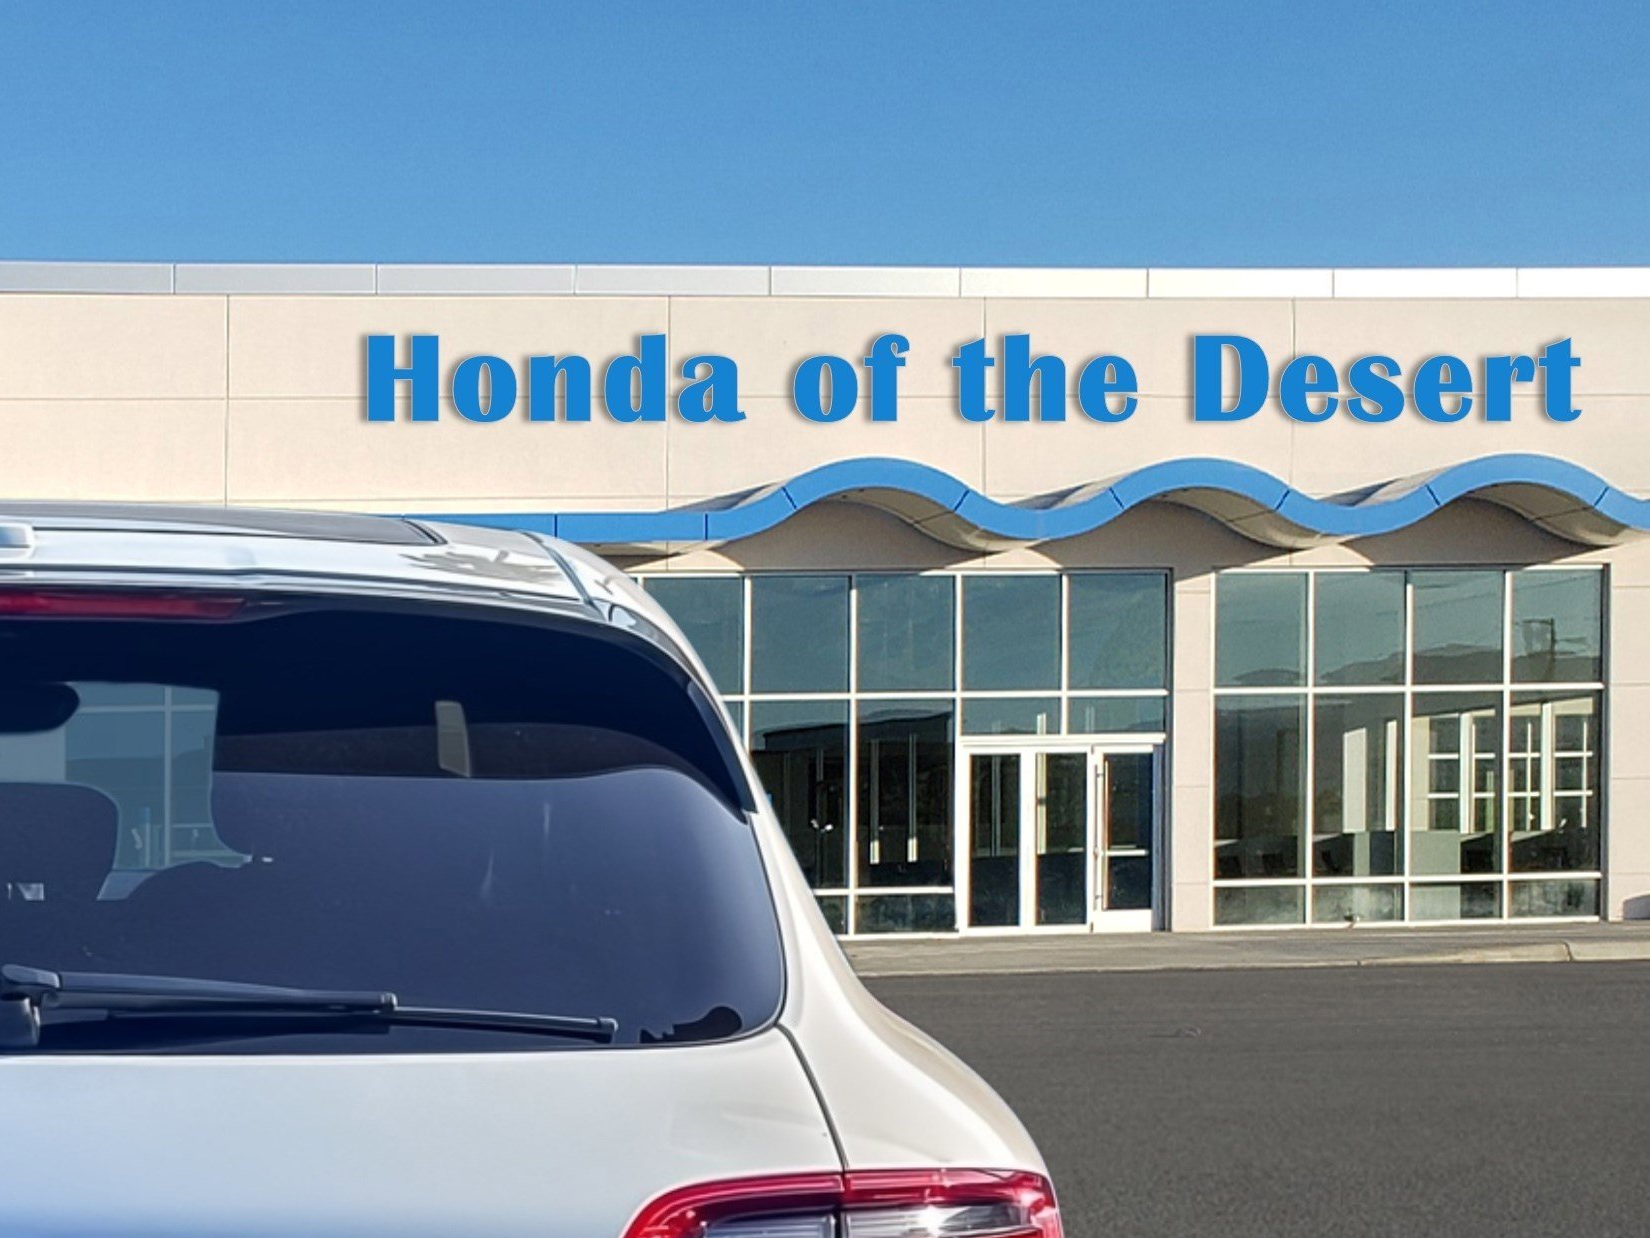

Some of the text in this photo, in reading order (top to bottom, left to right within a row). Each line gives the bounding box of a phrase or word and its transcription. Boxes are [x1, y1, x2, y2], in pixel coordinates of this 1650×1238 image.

[366, 333, 1582, 423] Honda of the Desert
